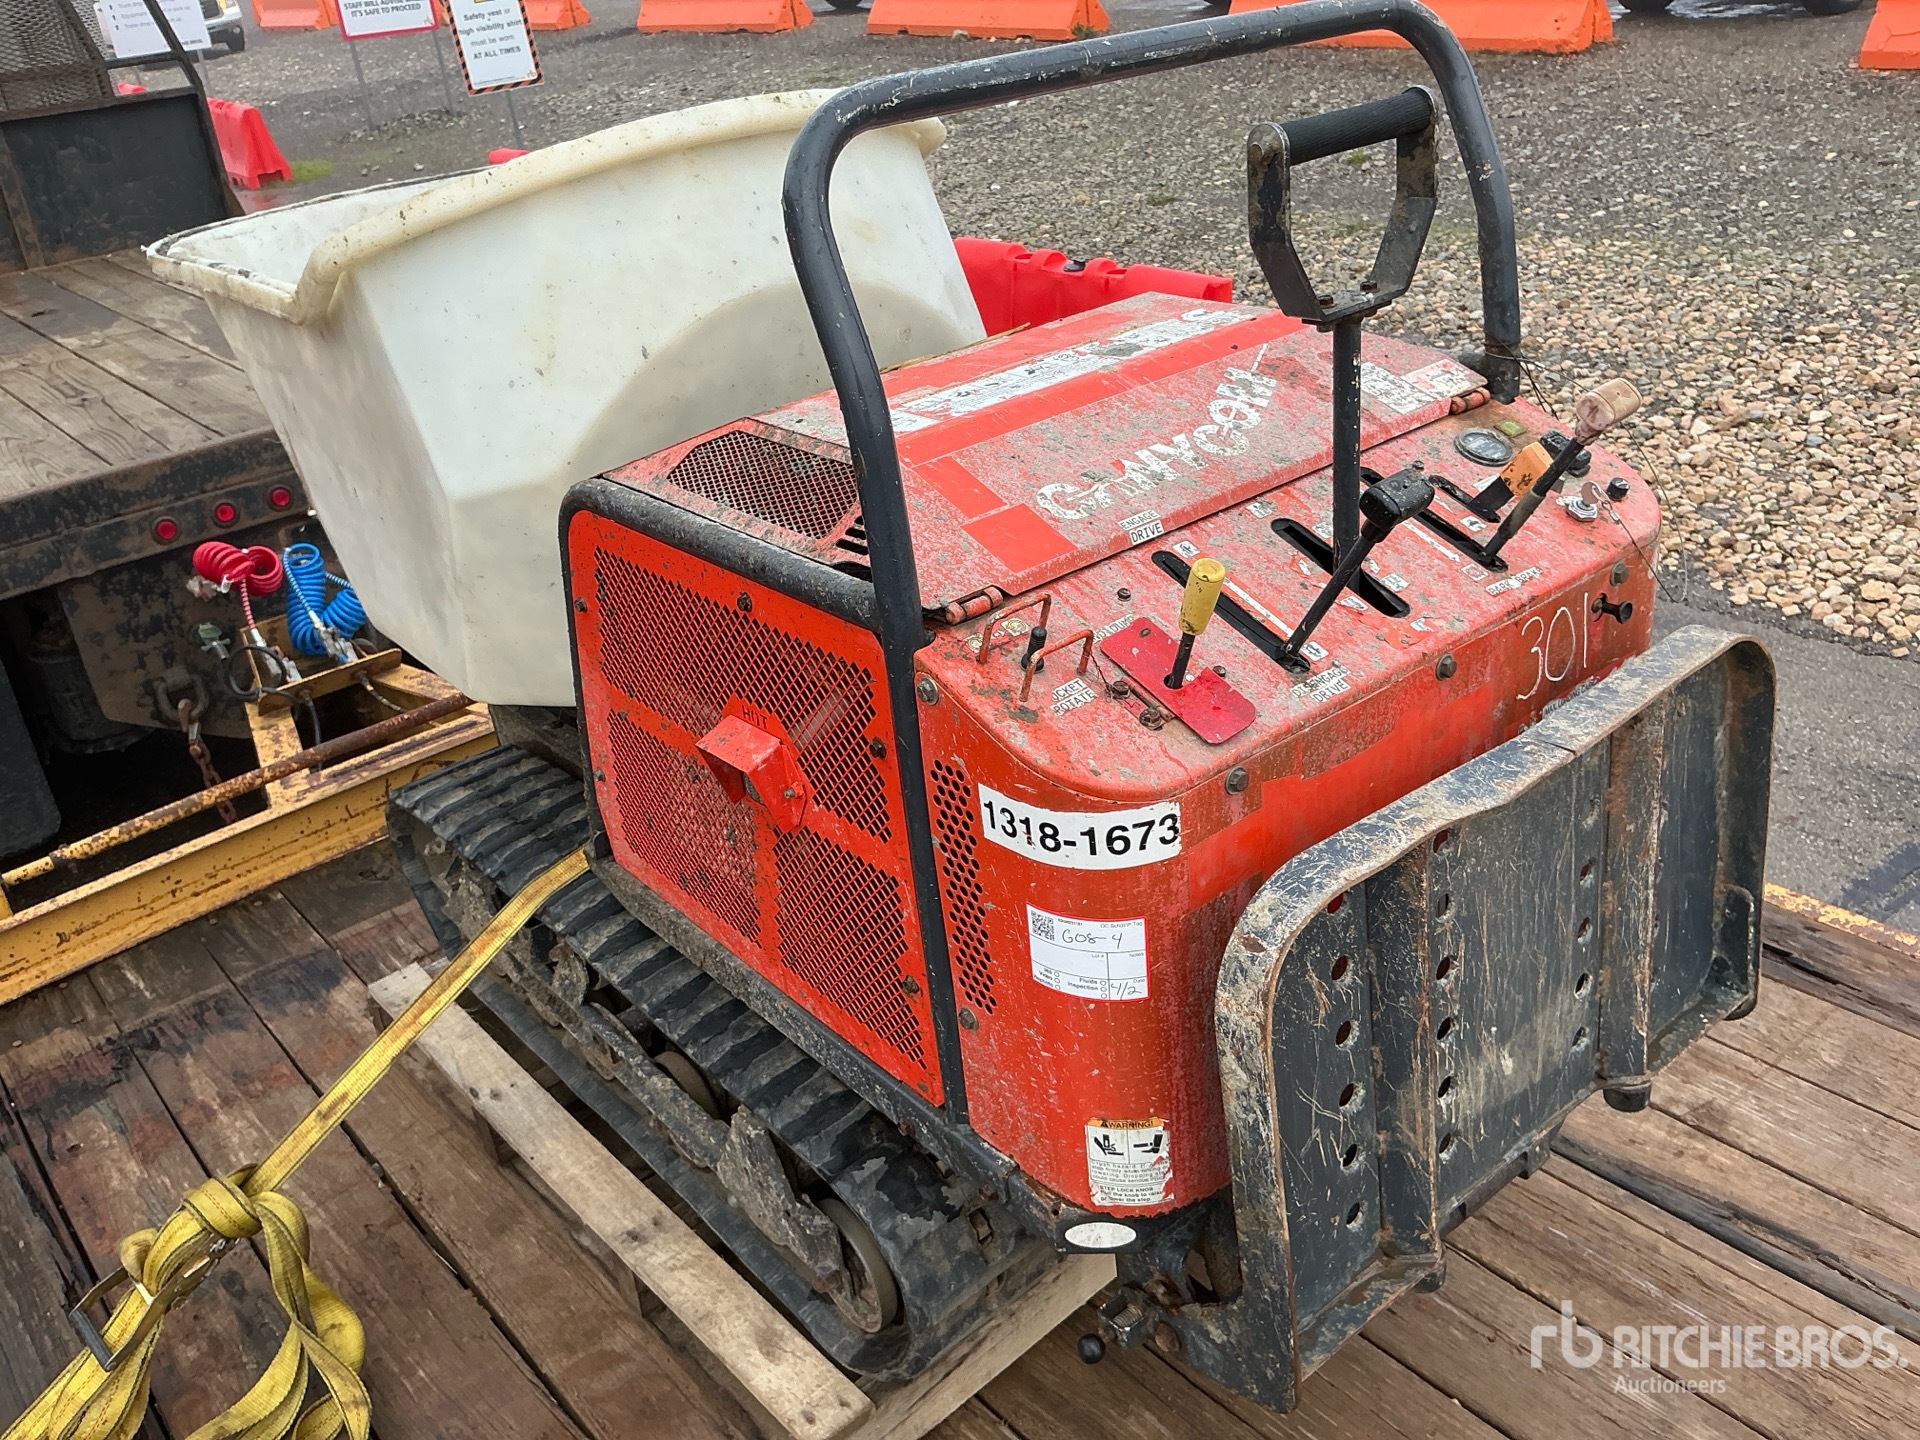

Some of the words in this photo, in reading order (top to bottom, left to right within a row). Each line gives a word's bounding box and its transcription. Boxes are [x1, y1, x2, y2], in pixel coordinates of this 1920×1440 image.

[364, 8, 380, 16] SAFE
[381, 6, 391, 14] TO
[391, 3, 421, 13] PROCEED
[464, 12, 485, 21] Safety
[459, 27, 475, 36] high
[476, 23, 505, 32] visibility
[507, 19, 522, 27] shirt
[484, 50, 498, 58] ALL
[500, 46, 521, 55] TIMES
[1120, 510, 1158, 529] ENGAGE
[1131, 522, 1163, 543] DRIVE
[1516, 592, 1589, 700] 301
[1052, 679, 1083, 701] UCKET
[1313, 680, 1347, 702] DRIVE
[1053, 690, 1096, 716] ROTATE
[983, 800, 1180, 856] 1318-1673
[1067, 981, 1099, 991] Inspection
[1079, 977, 1098, 985] Fluids
[1108, 1120, 1154, 1129] WARNING!
